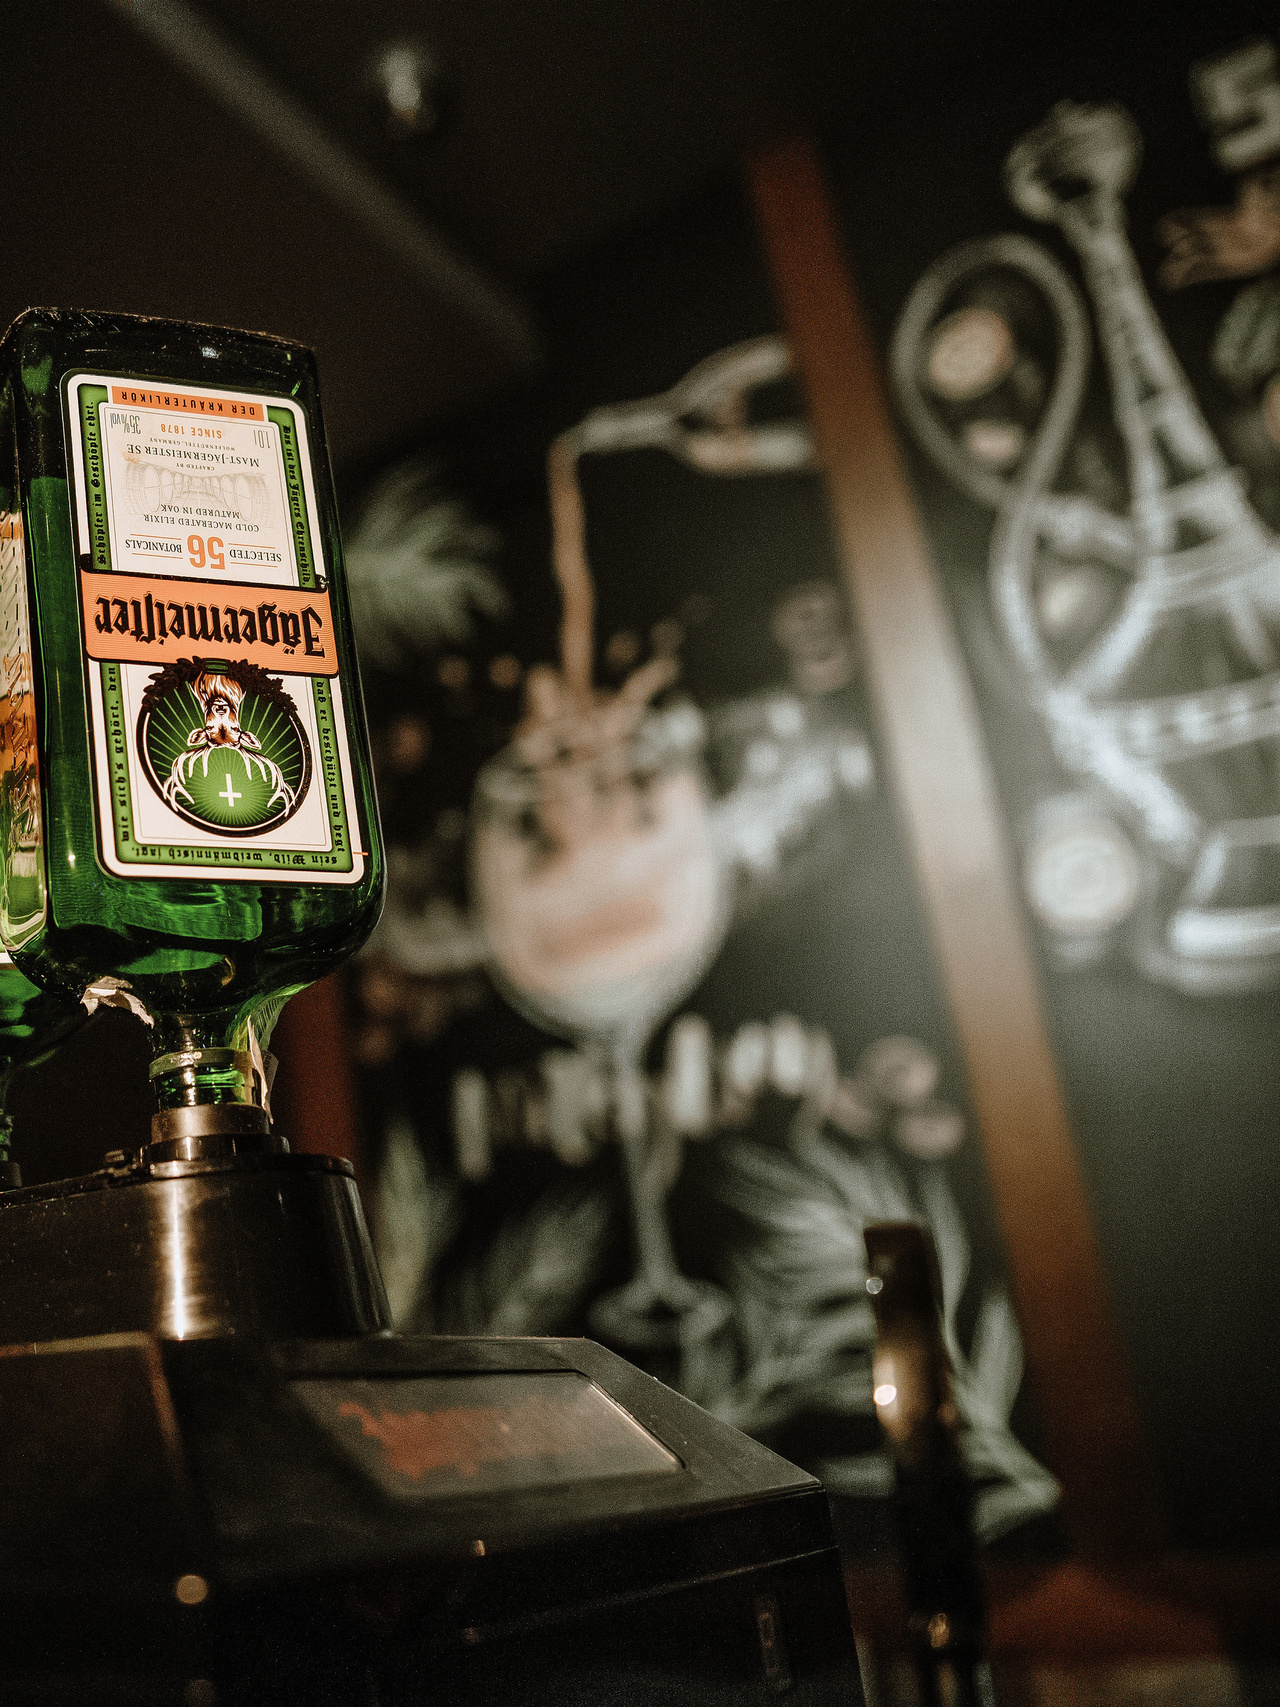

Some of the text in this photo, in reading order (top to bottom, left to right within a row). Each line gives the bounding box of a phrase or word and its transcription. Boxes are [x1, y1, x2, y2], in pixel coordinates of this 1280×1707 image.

[120, 391, 255, 416] DER KRÄUTERLIKÖR
[160, 424, 222, 439] SINCE 1878
[126, 443, 142, 454] SE
[186, 463, 215, 472] CRAFTED
[91, 493, 102, 506] im
[160, 504, 180, 513] OAK
[195, 507, 240, 519] MATURED
[143, 514, 260, 532] COLD MACERATED ELIXIR
[125, 534, 282, 570] SELECTED 56 BOTANICALS
[330, 794, 341, 818] und
